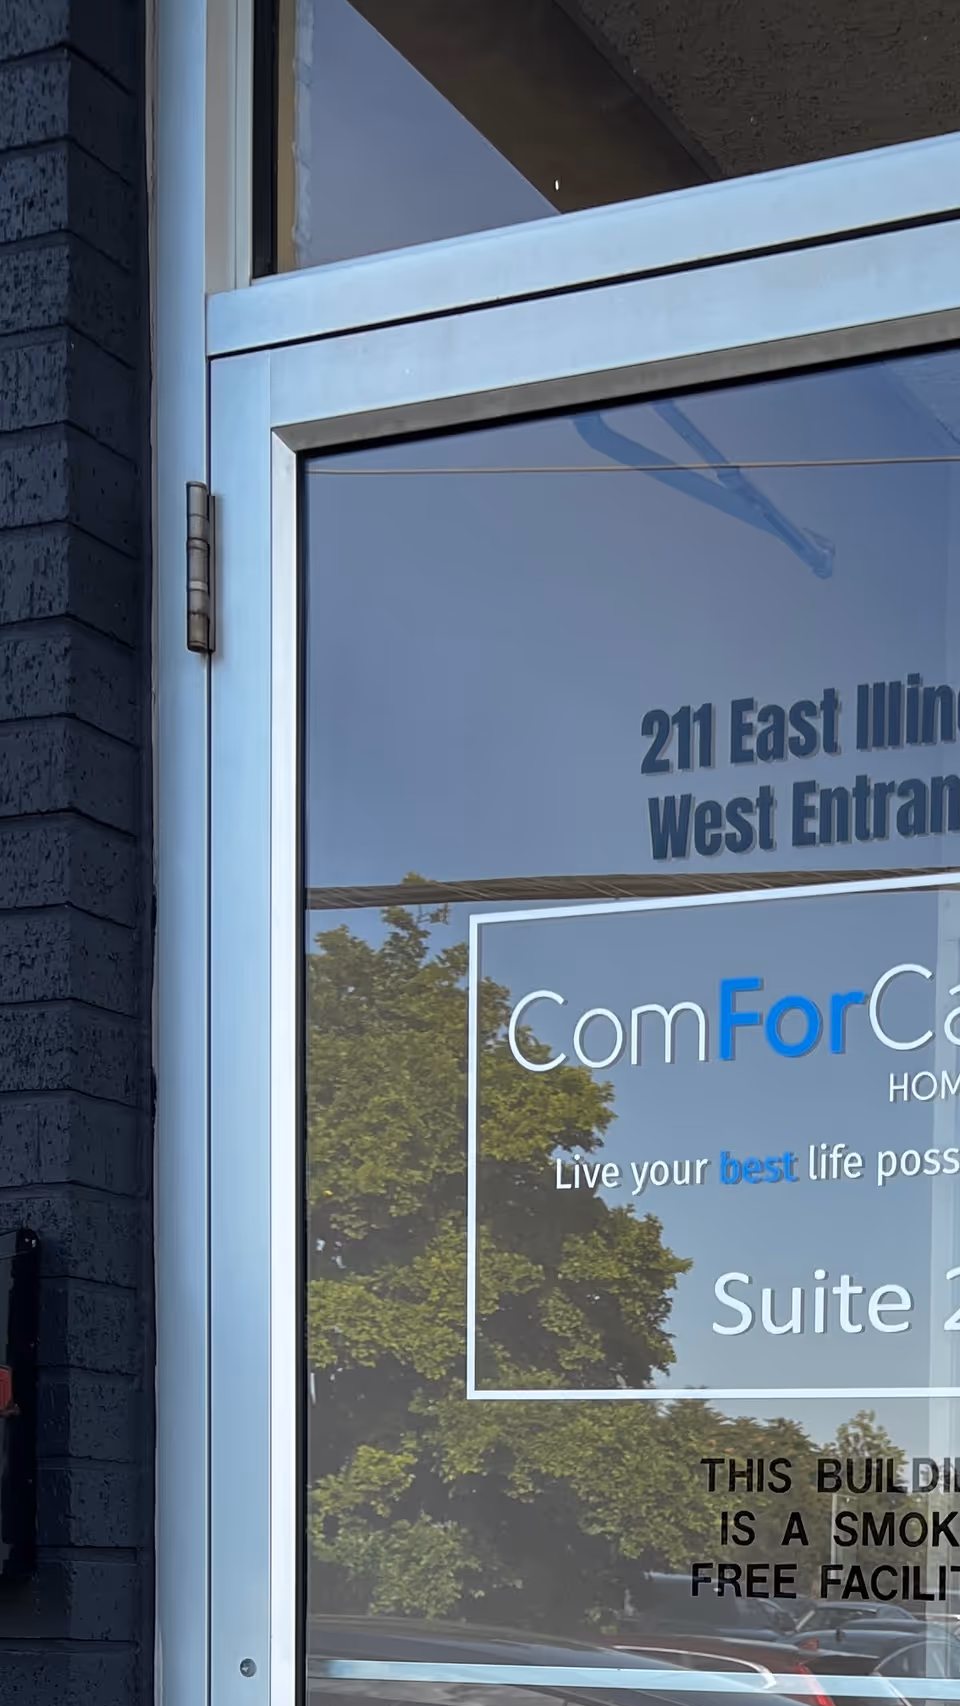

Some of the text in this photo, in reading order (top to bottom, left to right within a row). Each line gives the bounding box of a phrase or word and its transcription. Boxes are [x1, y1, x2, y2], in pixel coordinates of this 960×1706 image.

[641, 702, 716, 775] 211
[730, 688, 842, 764] East
[648, 784, 777, 861] West
[555, 1153, 621, 1190] Live
[630, 1158, 709, 1196] your
[719, 1150, 799, 1185] best
[808, 1143, 863, 1181] life
[712, 1268, 913, 1336] Suite
[700, 1457, 792, 1493] THIS
[721, 1510, 755, 1546] IS
[781, 1511, 809, 1547] A
[691, 1562, 798, 1600] FREE
